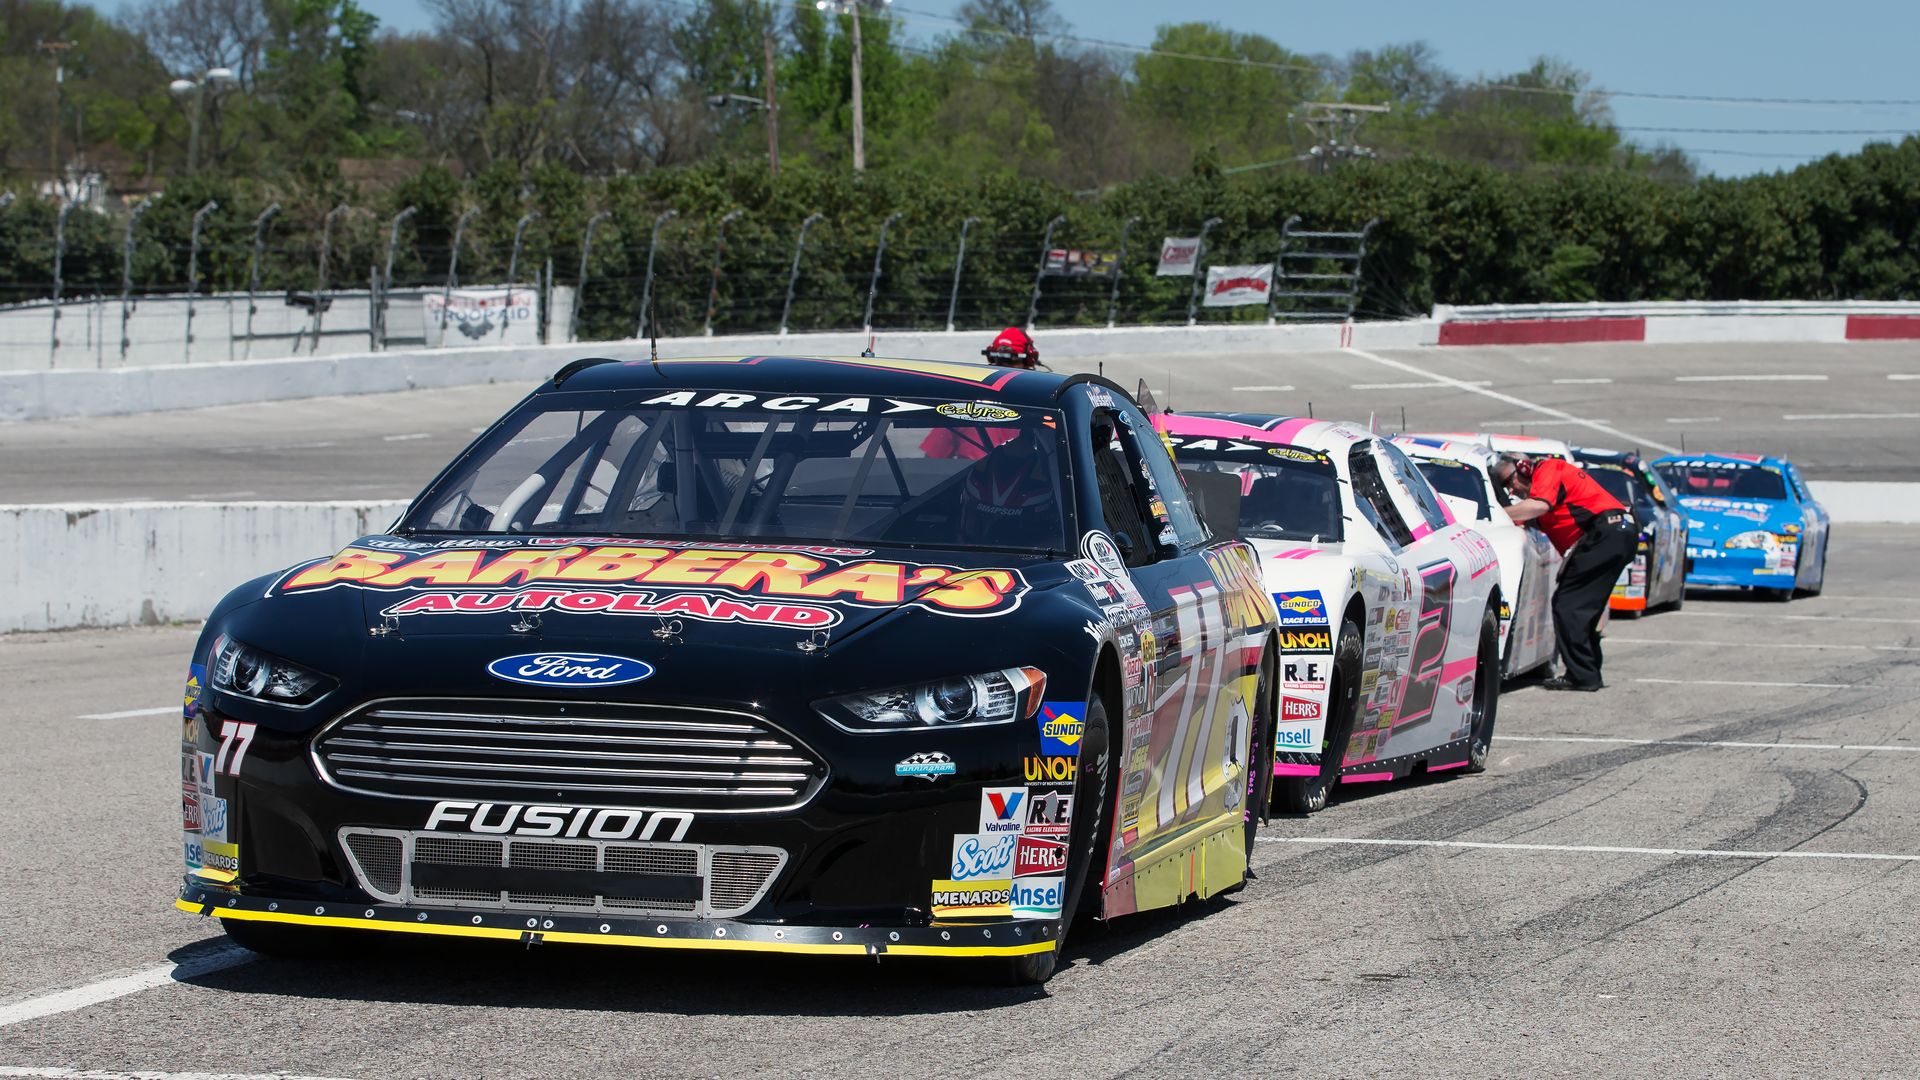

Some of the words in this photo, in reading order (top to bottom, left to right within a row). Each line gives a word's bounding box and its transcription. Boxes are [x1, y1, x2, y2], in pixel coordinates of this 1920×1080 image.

[640, 391, 870, 412] ARCA
[936, 402, 1019, 419] Calypso
[976, 503, 1024, 516] SIMPSON
[285, 545, 1015, 608] BARBERA'S
[403, 591, 831, 627] AUTOLAND
[1282, 600, 1319, 608] SUNOCO
[1280, 631, 1330, 648] UNOH
[521, 656, 622, 680] Ford
[1285, 701, 1318, 717] HERR'S
[1046, 723, 1084, 736] SUNOC
[1277, 728, 1311, 744] nsell
[215, 719, 257, 778] 77
[897, 763, 955, 773] Cunningham
[424, 801, 695, 842] FUSION
[951, 834, 1015, 881] Scott
[932, 889, 1010, 906] MENARDS
[1009, 881, 1062, 906] Ansel
